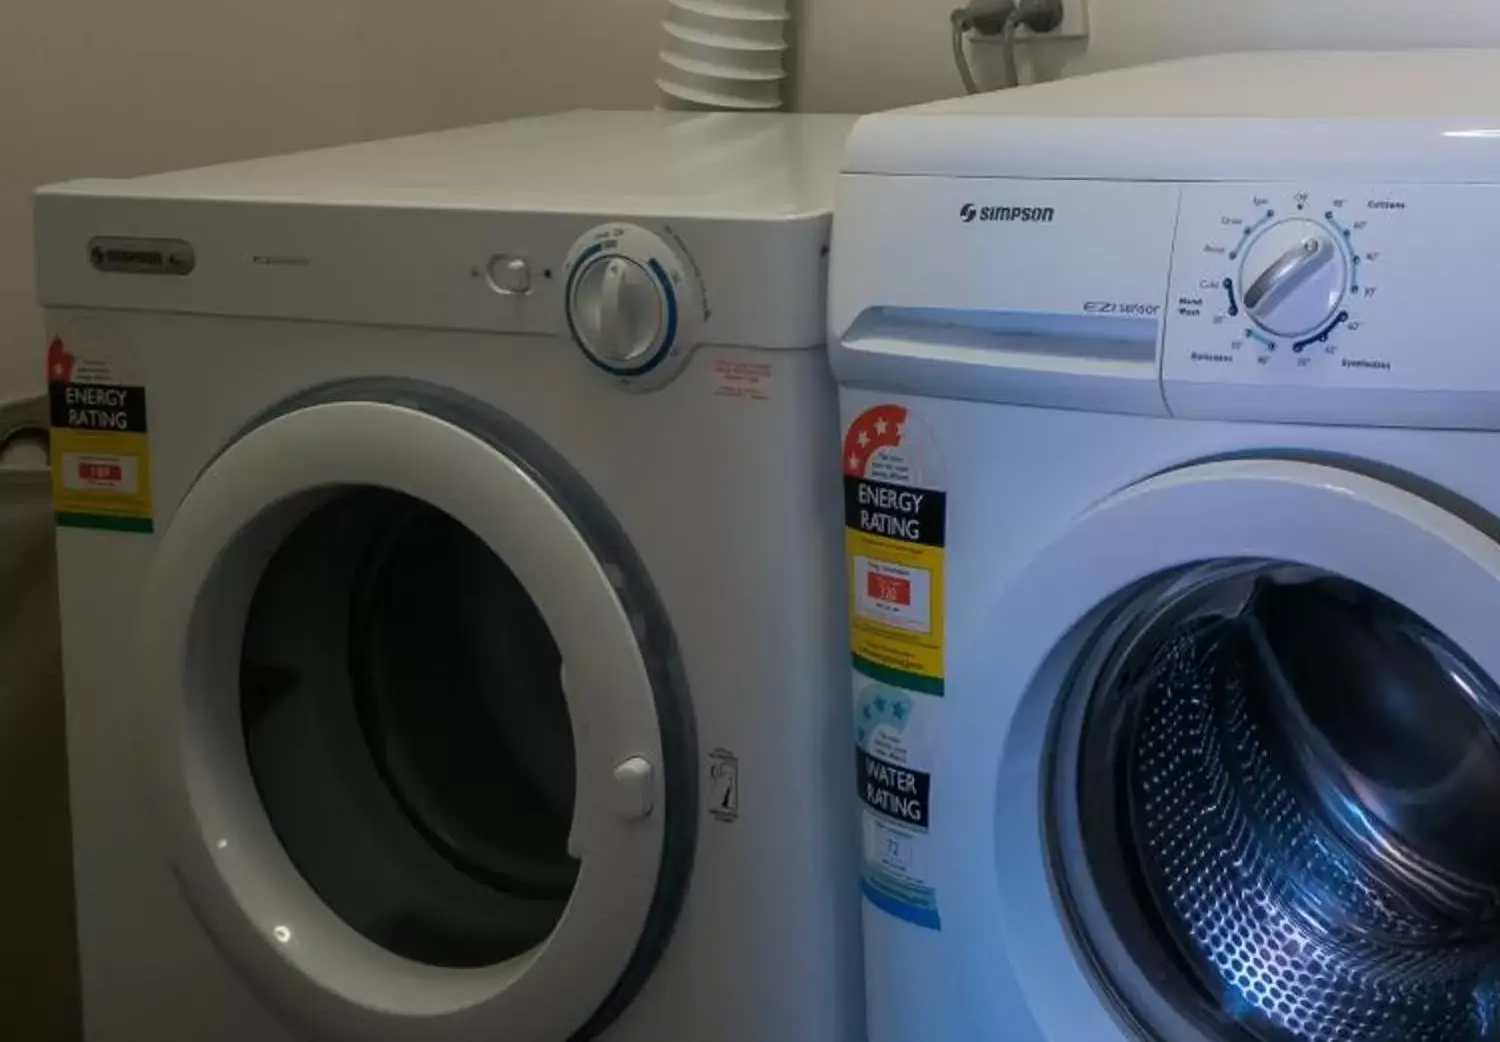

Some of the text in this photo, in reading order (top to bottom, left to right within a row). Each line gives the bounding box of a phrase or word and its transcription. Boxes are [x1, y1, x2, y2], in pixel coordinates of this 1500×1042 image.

[65, 387, 127, 407] ENERGY
[69, 408, 127, 429] RATING
[858, 483, 923, 514] ENERGY
[860, 509, 921, 540] RATING
[865, 756, 918, 796] WATER
[866, 782, 921, 822] RATING
